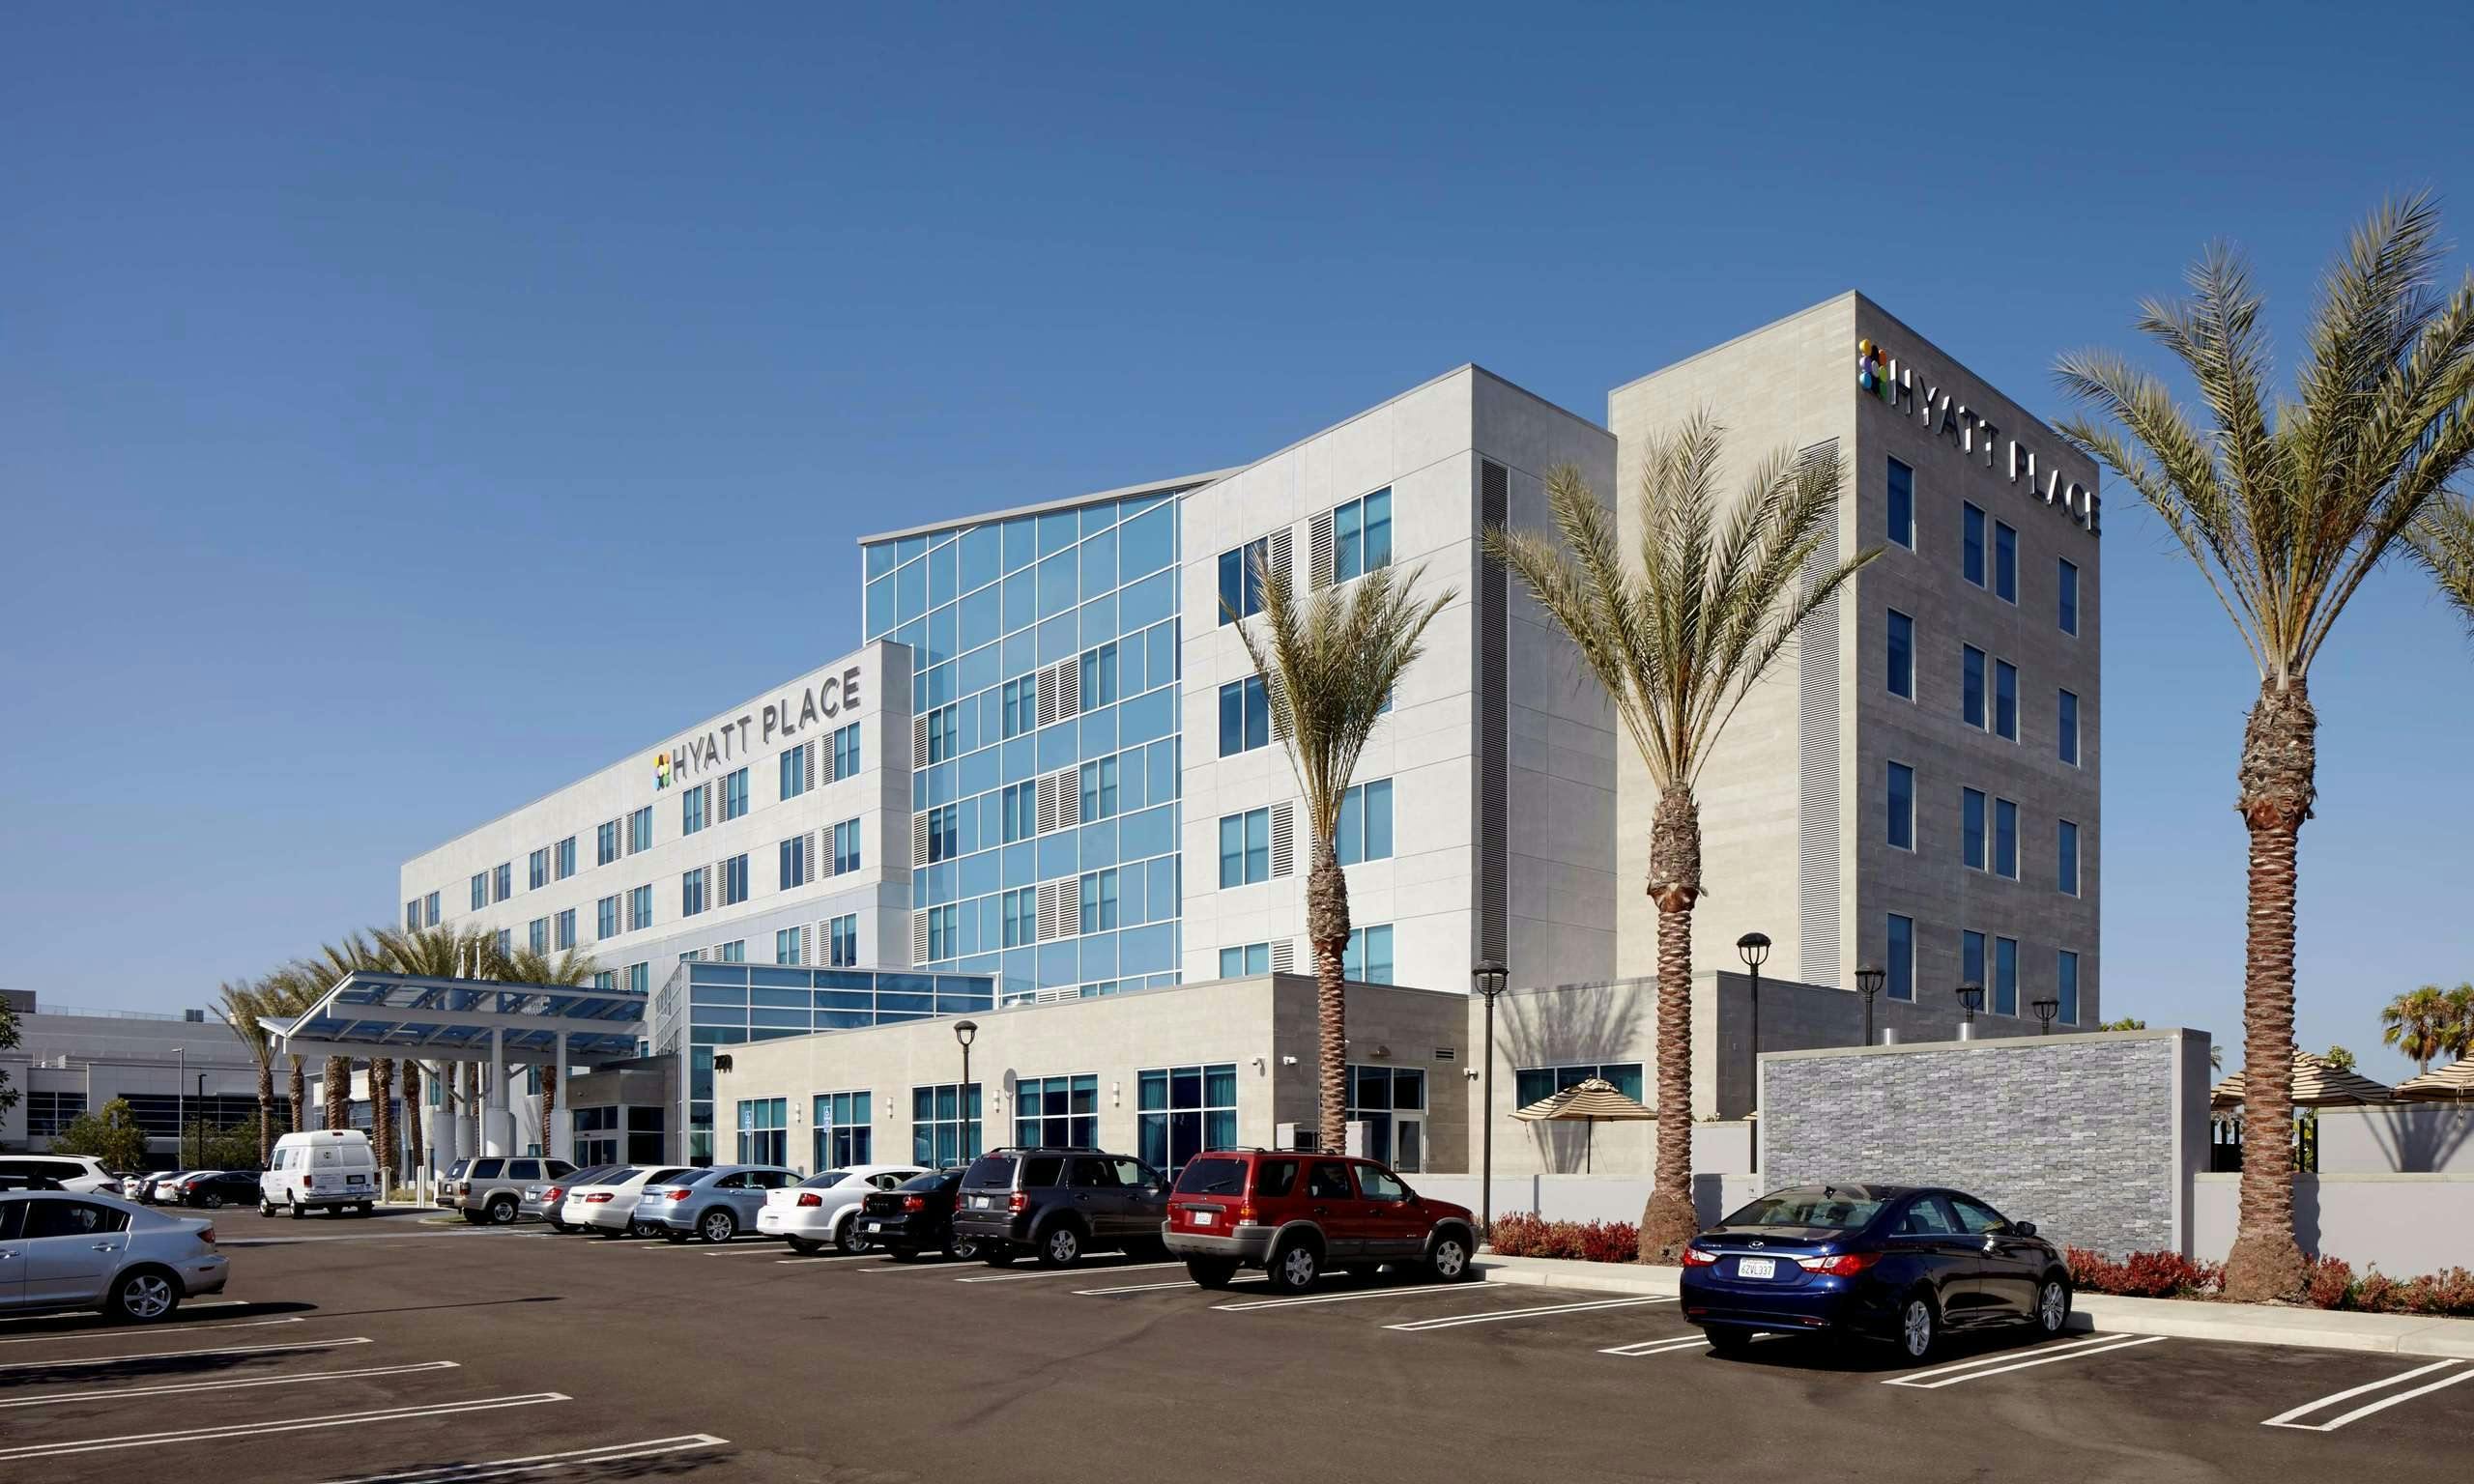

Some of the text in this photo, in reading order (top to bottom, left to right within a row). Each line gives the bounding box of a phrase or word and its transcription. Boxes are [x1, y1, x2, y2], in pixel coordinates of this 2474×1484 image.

[1889, 358, 2101, 535] HYATT PLACE
[673, 666, 860, 784] HYATT PLACE
